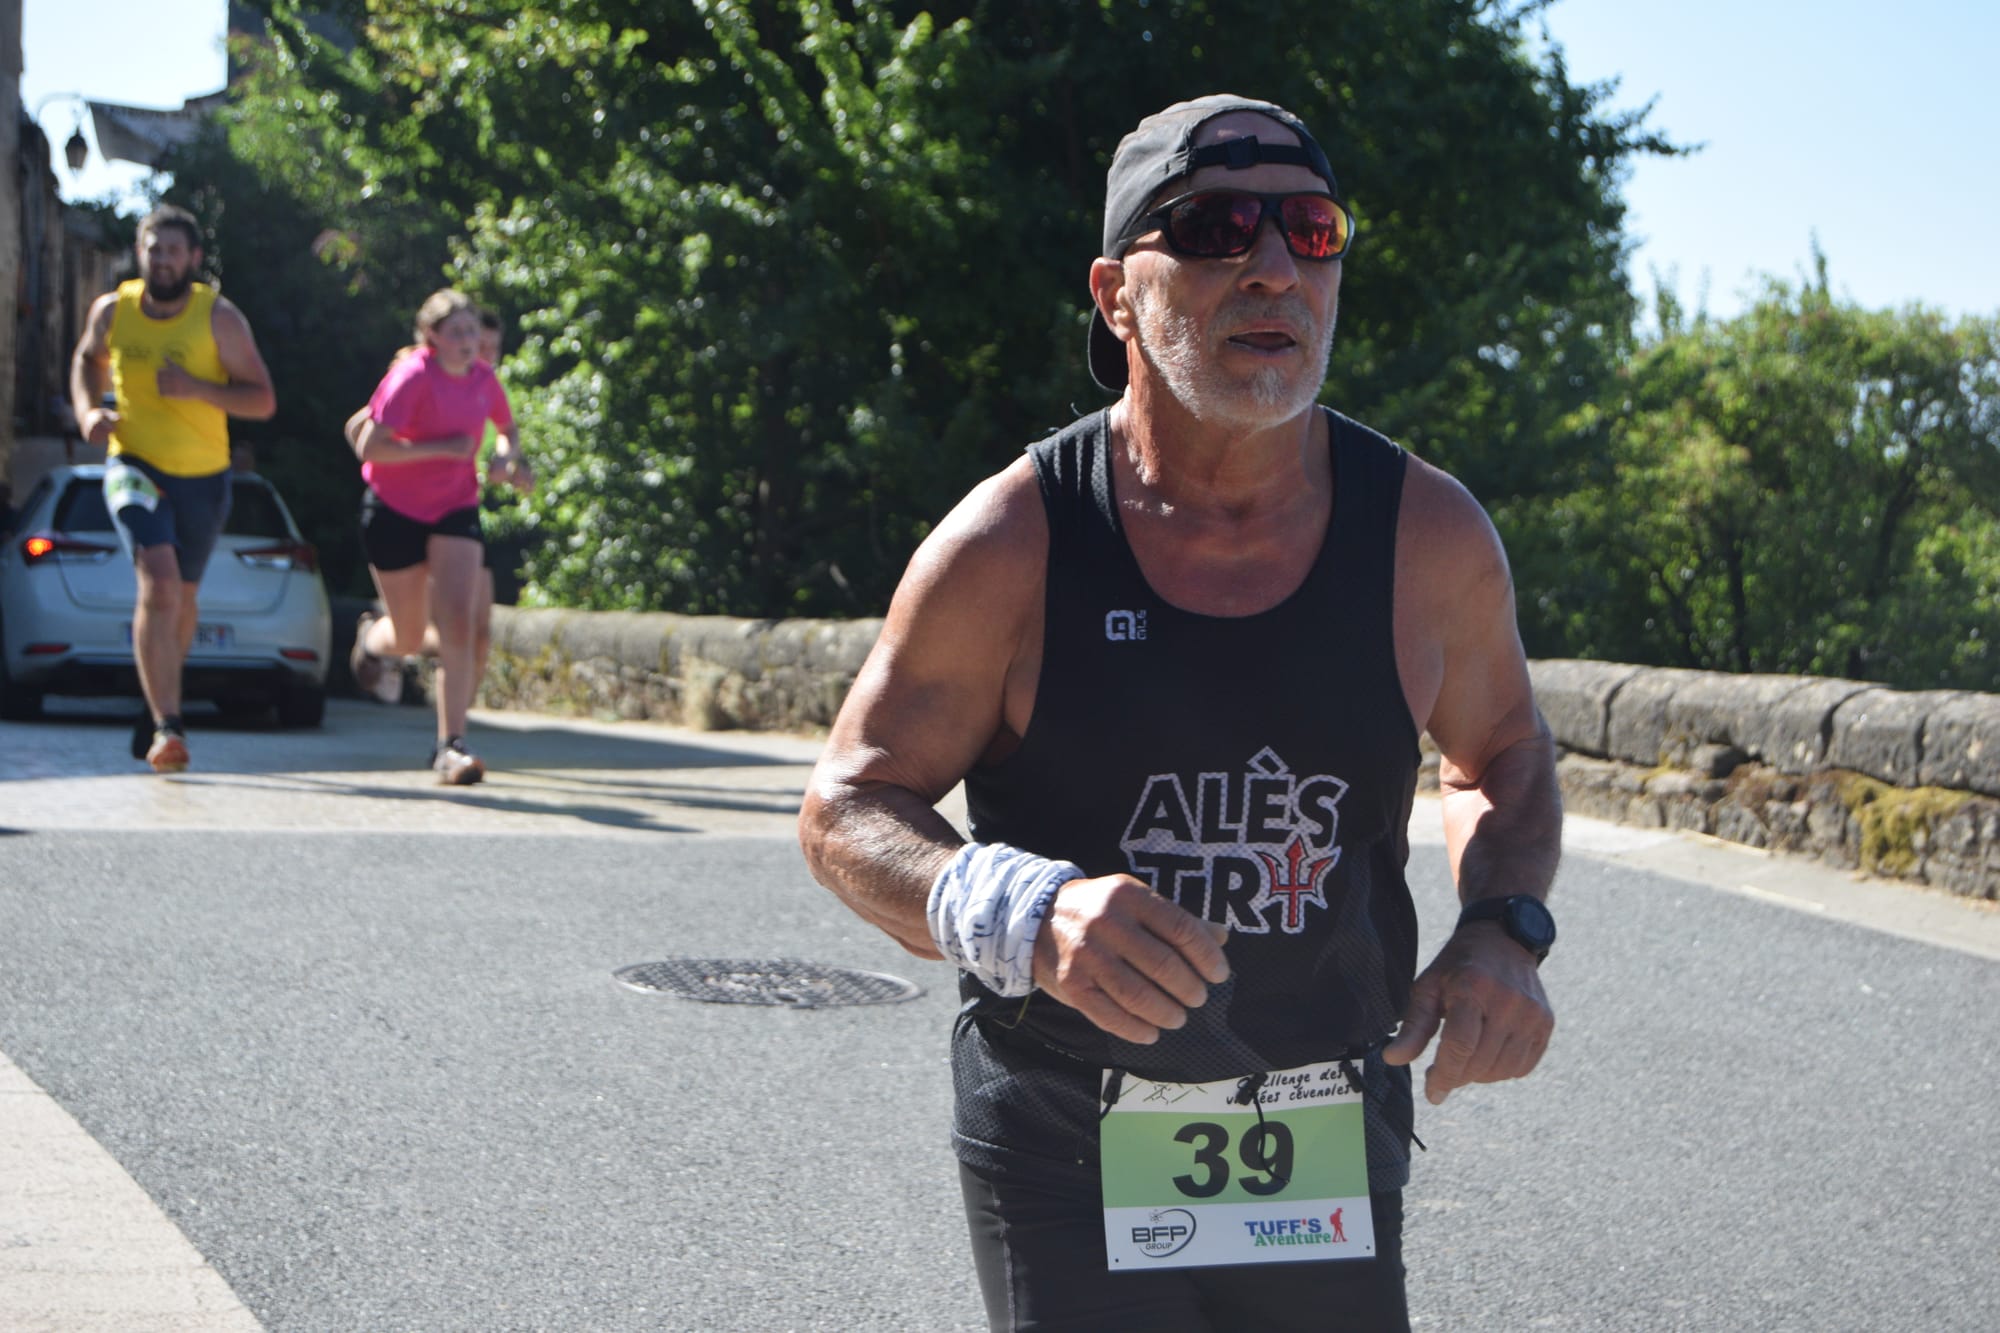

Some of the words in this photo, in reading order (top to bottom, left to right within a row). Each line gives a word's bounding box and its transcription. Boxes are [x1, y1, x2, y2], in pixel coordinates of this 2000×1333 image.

[1319, 1068, 1343, 1081] des
[1172, 1121, 1294, 1198] 39
[1131, 1225, 1187, 1243] BFP
[1244, 1218, 1322, 1236] TUFF'S
[1145, 1242, 1173, 1250] GROUP
[1254, 1232, 1332, 1246] Aventure
